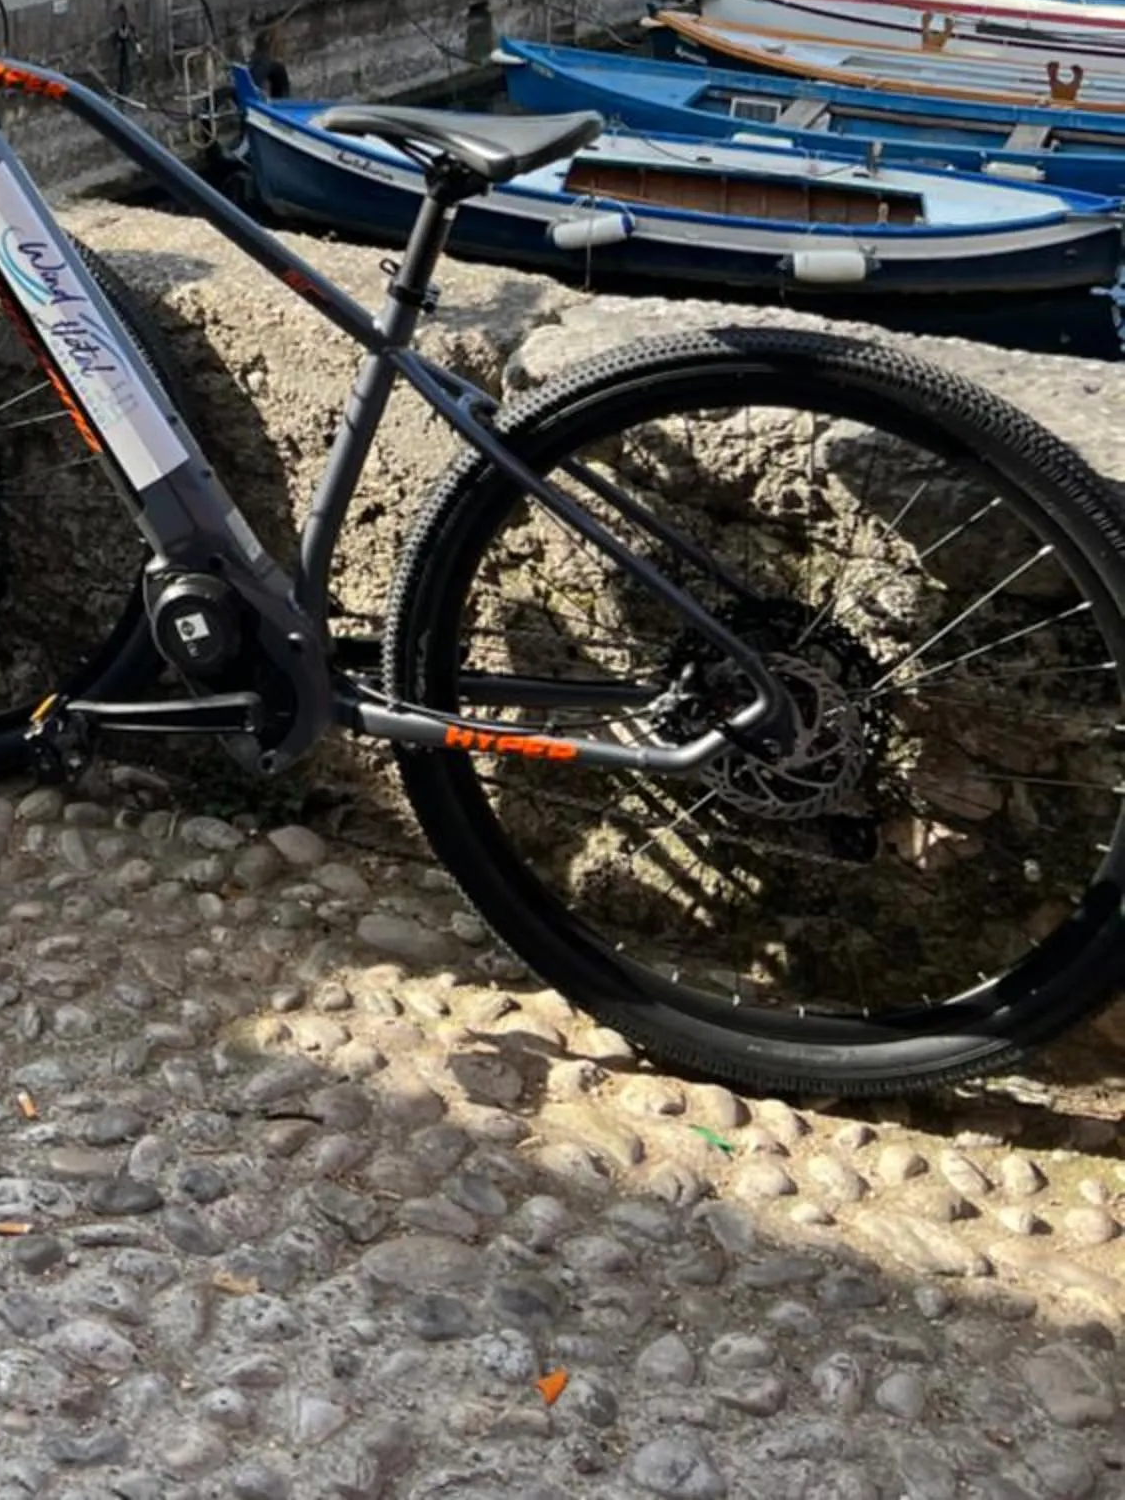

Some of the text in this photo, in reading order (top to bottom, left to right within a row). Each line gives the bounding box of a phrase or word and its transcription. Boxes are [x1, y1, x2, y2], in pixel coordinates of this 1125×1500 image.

[18, 242, 89, 305] Wind
[50, 321, 117, 379] Hotel
[445, 724, 578, 761] HYPER
